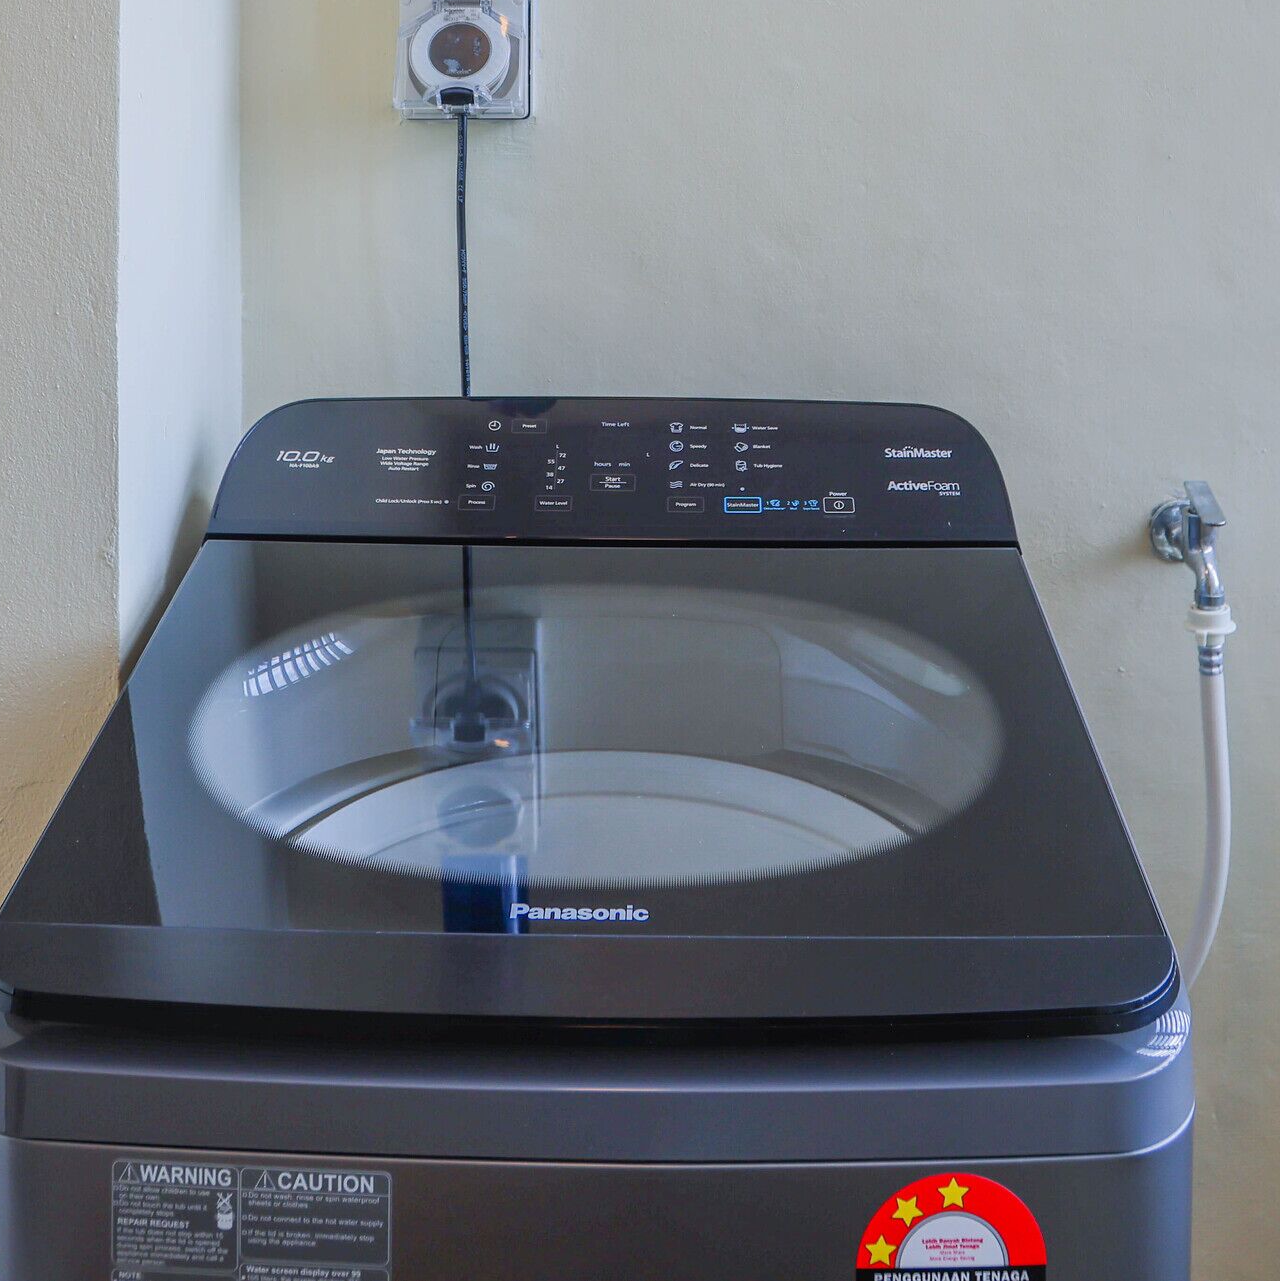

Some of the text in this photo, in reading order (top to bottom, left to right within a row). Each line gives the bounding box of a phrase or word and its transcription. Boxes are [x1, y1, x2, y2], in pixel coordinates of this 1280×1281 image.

[276, 450, 336, 463] 10.0 kg
[397, 448, 437, 456] Technology
[884, 446, 953, 458] StainMaster
[887, 480, 960, 491] ActiveFoam
[509, 903, 650, 921] Panasonic
[140, 1164, 231, 1186] WARNING
[277, 1172, 375, 1193] CAUTION
[117, 1217, 190, 1229] REPAIR REQUEST
[246, 1265, 270, 1274] Water
[271, 1266, 298, 1275] screen
[300, 1267, 330, 1278] display
[874, 1270, 1030, 1281] PENGGUNAAN TENAGA
